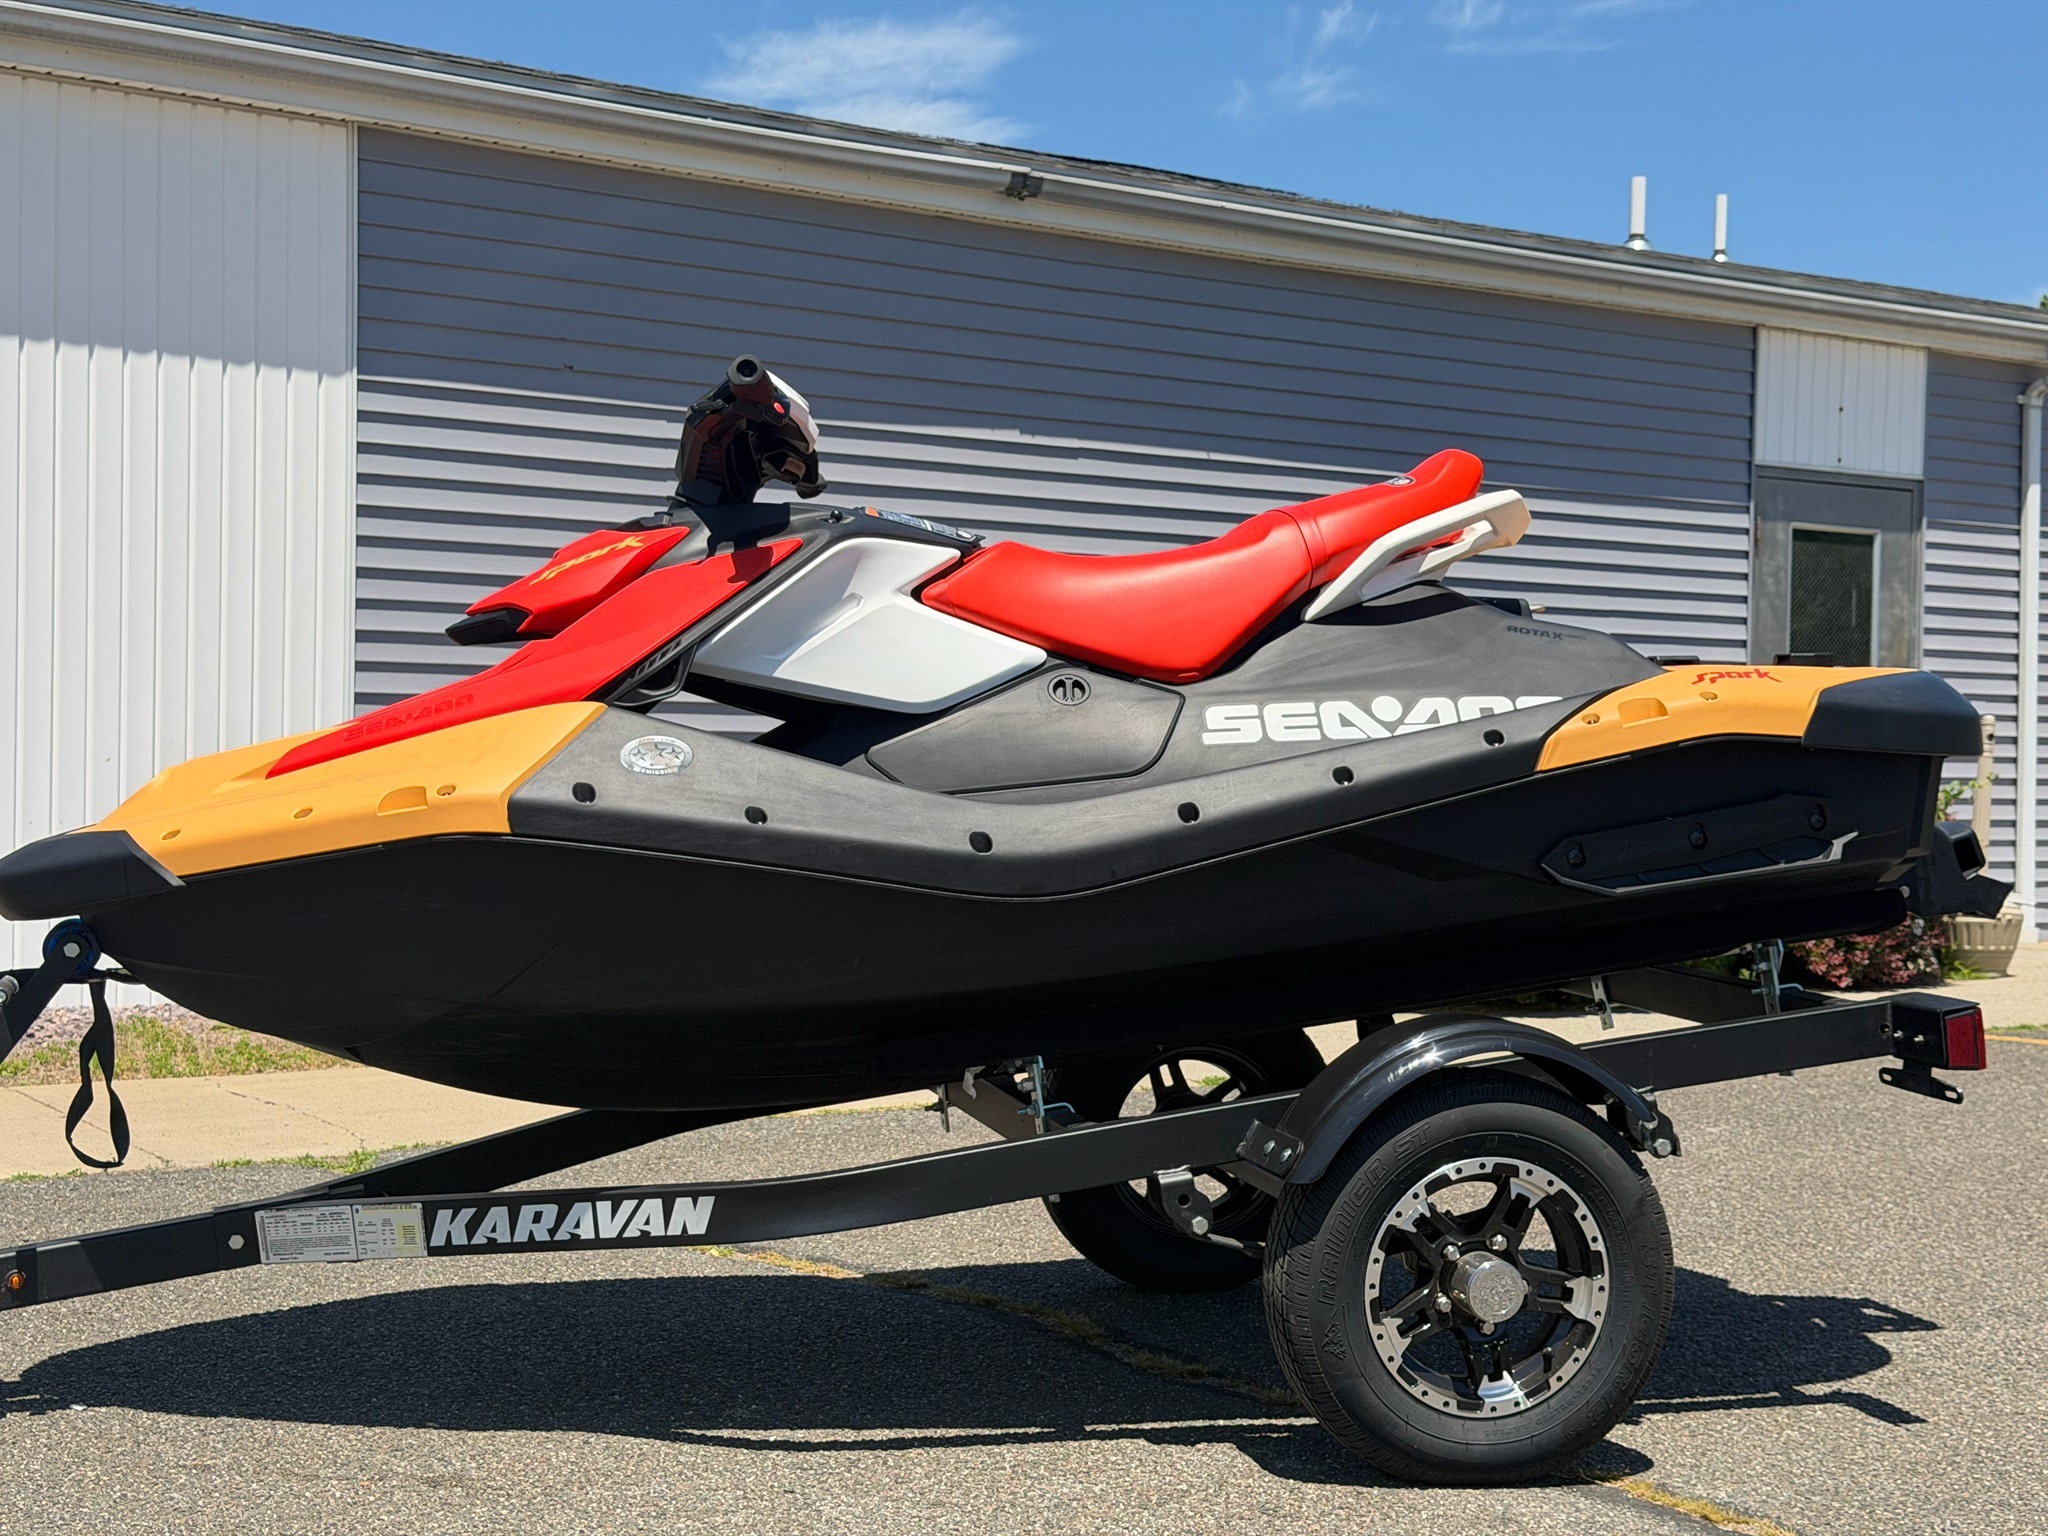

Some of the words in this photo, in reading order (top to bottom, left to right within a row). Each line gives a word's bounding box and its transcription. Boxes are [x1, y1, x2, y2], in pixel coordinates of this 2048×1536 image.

[1506, 625, 1564, 641] ROTAX
[429, 1195, 717, 1247] KARAVAN
[1317, 1157, 1389, 1306] RAINIER
[1392, 1121, 1431, 1162] ST
